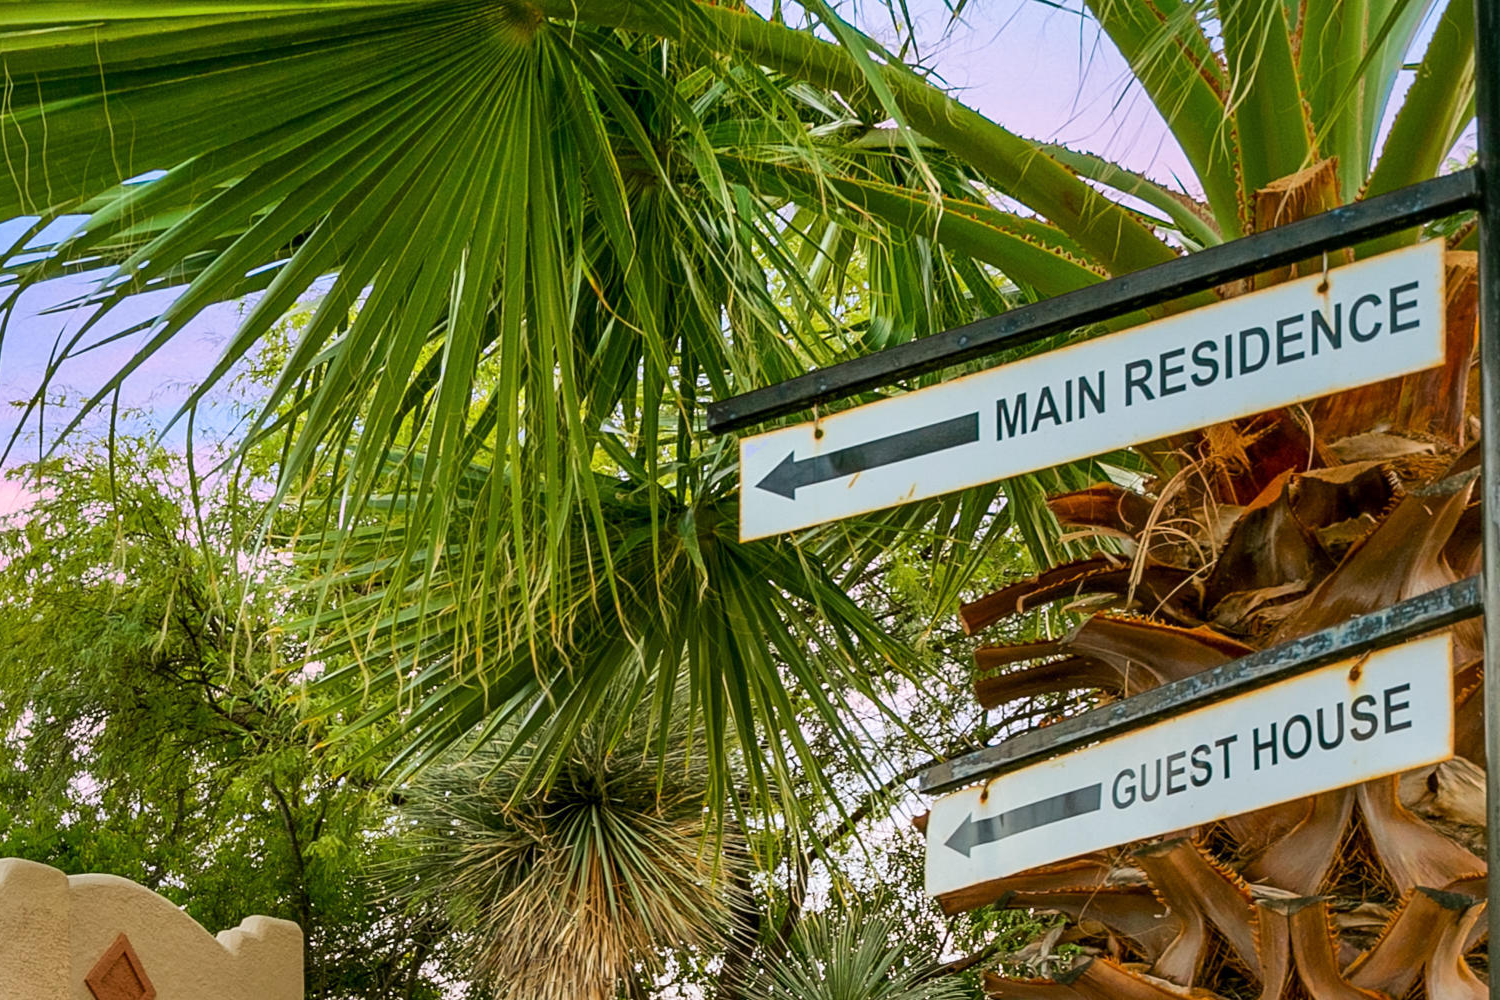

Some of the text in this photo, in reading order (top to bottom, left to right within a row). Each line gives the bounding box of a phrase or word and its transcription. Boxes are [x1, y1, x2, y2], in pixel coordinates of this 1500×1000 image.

[996, 281, 1421, 441] MAIN RESIDENCE
[1111, 684, 1412, 810] GUEST HOUSE
